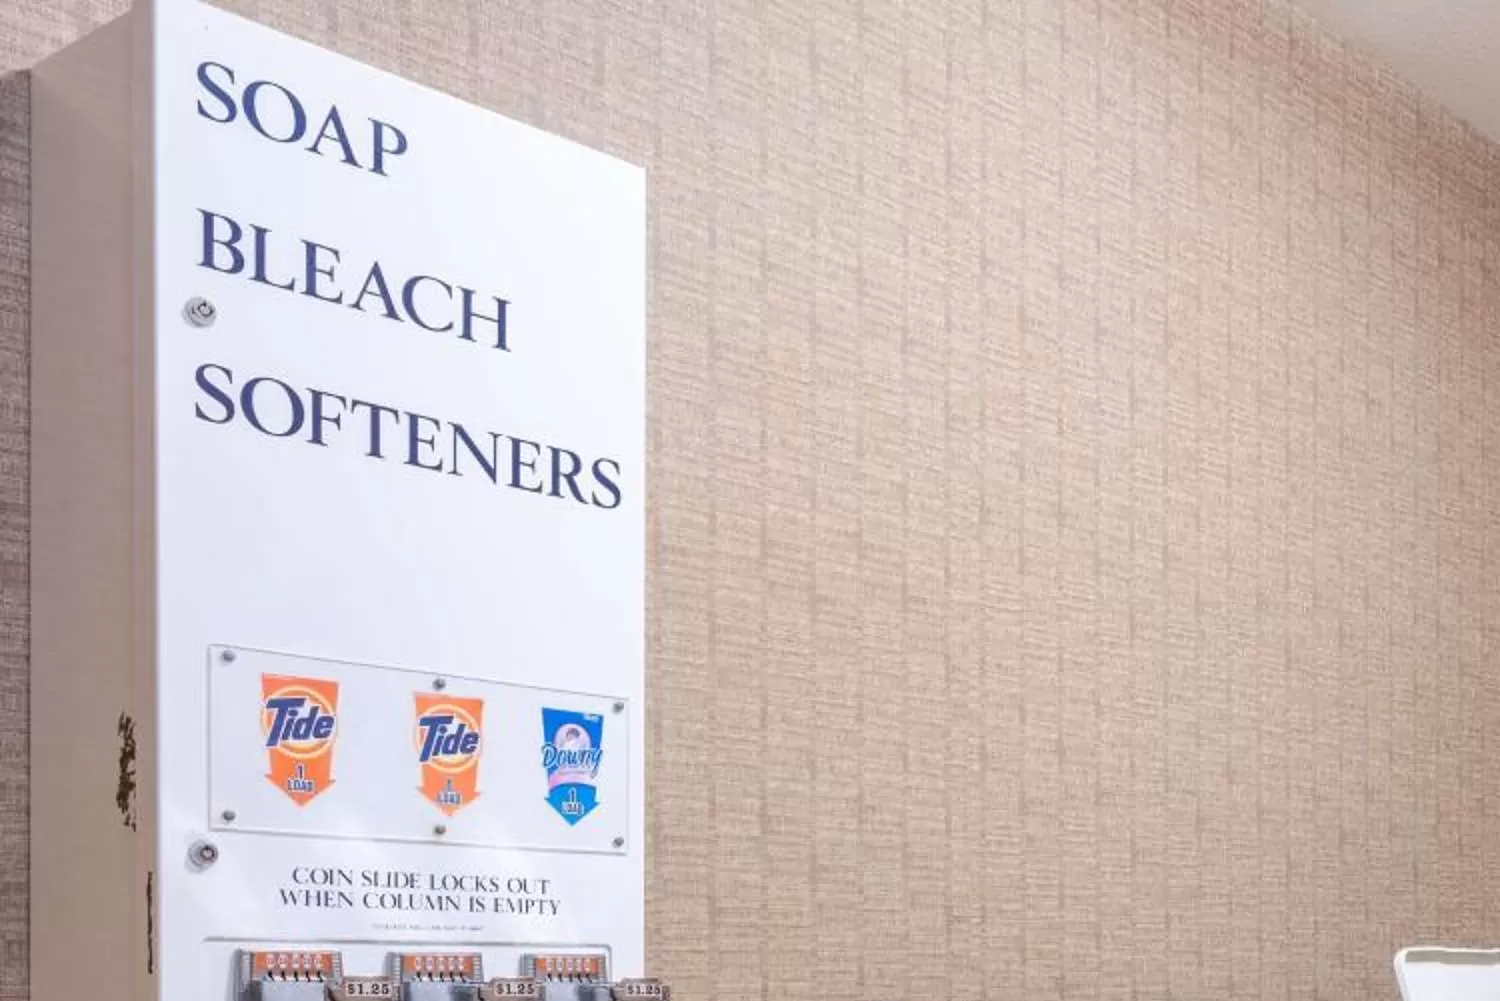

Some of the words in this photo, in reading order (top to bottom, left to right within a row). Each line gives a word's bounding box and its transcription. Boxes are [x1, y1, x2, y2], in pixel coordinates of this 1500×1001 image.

[196, 60, 408, 177] SOAP
[196, 207, 512, 353] BLEACH
[194, 362, 622, 509] SOFTENERS
[265, 697, 335, 747] Tide
[418, 715, 479, 762] Tide
[296, 763, 303, 779] 1
[541, 742, 603, 779] Downy
[287, 779, 314, 792] LOAD
[568, 787, 577, 802] 1
[292, 867, 353, 886] COIN
[361, 869, 420, 889] SLIDE
[428, 873, 499, 893] LOCKS
[507, 877, 551, 895] OUT
[279, 888, 353, 908] WHEN
[363, 891, 460, 912] COLUMN
[469, 895, 486, 913] IS
[493, 896, 561, 915] EMPTY
[347, 983, 389, 995] $1.25
[495, 983, 535, 995] $1.25
